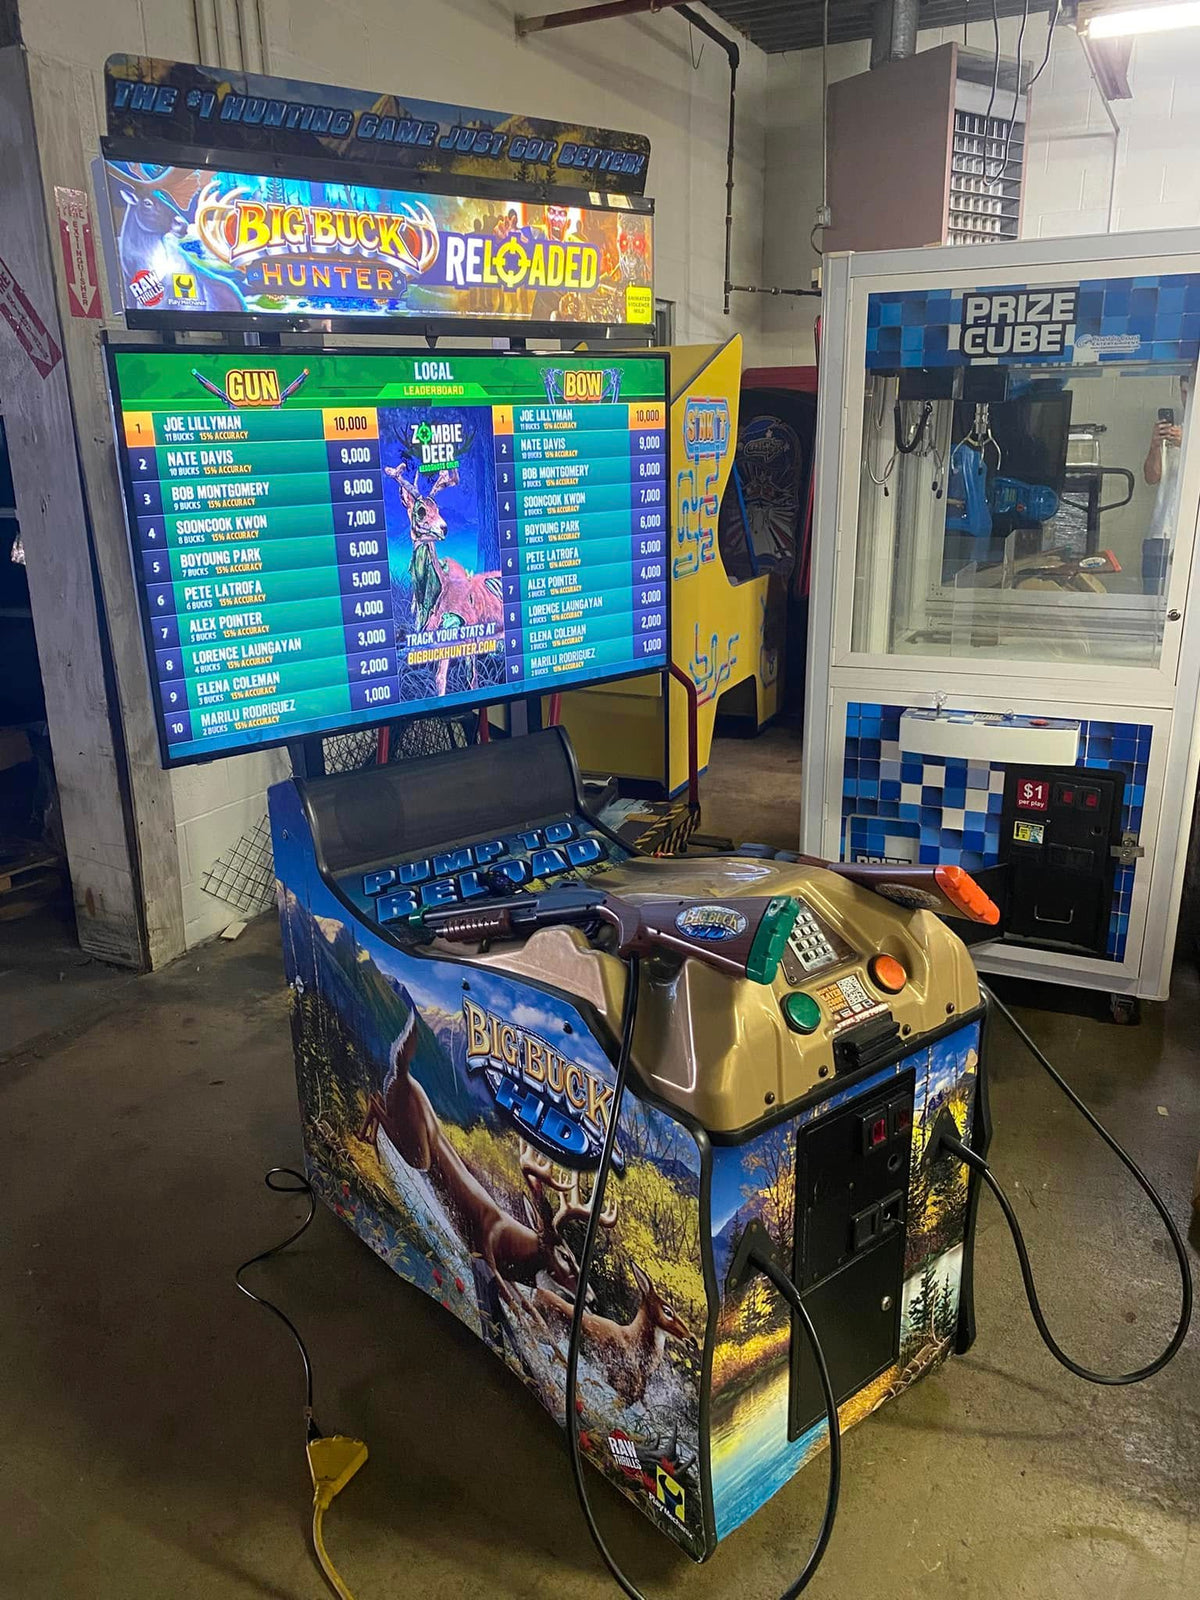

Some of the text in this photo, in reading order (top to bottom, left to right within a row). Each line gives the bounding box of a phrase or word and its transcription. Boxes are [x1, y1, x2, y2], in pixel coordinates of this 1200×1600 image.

[113, 80, 645, 175] THE #1 HUNTING GAME JUST GOT BETTER!
[234, 202, 419, 270] BIG BUCK
[72, 220, 88, 306] EXTINGUISHER
[447, 236, 597, 288] RELOADED
[130, 270, 160, 297] RAW
[262, 263, 393, 291] HUNTER
[138, 283, 164, 304] THRILLS
[966, 292, 1076, 324] PRIZE
[414, 362, 454, 380] LOCAL
[228, 371, 279, 401] GUN
[404, 386, 464, 396] LEADERBOARD
[565, 372, 602, 397] BOW
[333, 416, 367, 431] 10,000
[501, 415, 504, 423] 1
[520, 409, 572, 422] JOE LILLYMAN
[636, 410, 659, 423] 10,000
[136, 424, 141, 434] 1
[164, 416, 241, 432] JOE LILLYMAN
[215, 431, 248, 440] ACCURACY
[411, 422, 463, 445] ZOMBIE
[502, 444, 506, 453] 2
[521, 438, 566, 451] NATE DAVIS
[640, 436, 660, 450] 9,000
[167, 450, 234, 466] NATE DAVIS
[341, 448, 371, 464] 9,000
[422, 444, 454, 464] DEER
[139, 459, 147, 470] 2
[178, 467, 200, 476] BUCKS
[203, 466, 217, 475] 15%
[219, 465, 252, 474] ACCURACY
[522, 464, 589, 480] BOB MONTGOMERY
[640, 463, 660, 477] 8,000
[503, 473, 508, 483] 3
[172, 482, 269, 500] BOB MONTGOMERY
[344, 479, 373, 495] 8,000
[144, 494, 151, 505] 3
[524, 492, 585, 508] SOONCOOK KWON
[640, 488, 660, 503] 7,000
[180, 502, 201, 510] BUCKS
[207, 500, 221, 508] 15%
[223, 498, 255, 507] ACCURACY
[504, 502, 510, 511] 4
[176, 515, 268, 535] SOONCOOK KWON
[347, 510, 376, 527] 7,000
[640, 514, 660, 528] 6,000
[148, 528, 156, 538] 4
[506, 530, 511, 540] 5
[525, 520, 579, 536] BOYOUNG PARK
[184, 535, 205, 543] BUCKS
[226, 530, 259, 540] ACCURACY
[350, 540, 378, 557] 6,000
[640, 539, 660, 554] 5,000
[180, 548, 261, 568] BOYOUNG PARK
[507, 558, 512, 567] 6
[526, 547, 579, 563] PETE LATROFA
[153, 562, 160, 573] 5
[188, 568, 208, 576] BUCKS
[215, 566, 228, 574] 15%
[230, 562, 263, 573] ACCURACY
[641, 564, 661, 579] 4,000
[352, 571, 381, 587] 5,000
[528, 574, 577, 590] ALEX POINTER
[184, 580, 262, 601] PETE LATROFA
[509, 586, 513, 594] 7
[641, 590, 661, 604] 3,000
[157, 595, 164, 606] 6
[355, 600, 384, 617] 4,000
[529, 596, 602, 617] LORENCE LAUNGAYAN
[190, 612, 263, 633] ALEX POINTER
[510, 612, 515, 621] 8
[641, 614, 661, 629] 2,000
[161, 628, 168, 638] 7
[358, 629, 386, 646] 3,000
[406, 623, 496, 647] TRACK YOUR STATS AT
[530, 624, 586, 643] ELENA COLEMAN
[192, 638, 302, 665] LORENCE LAUNGAYAN
[511, 639, 516, 648] 9
[643, 638, 661, 652] 1,000
[408, 640, 496, 665] BIGBUCKHUNTER.COM
[531, 648, 596, 669] MARILU RODRIGUEZ
[166, 660, 173, 670] 8
[360, 658, 388, 674] 2,000
[511, 665, 518, 674] 10
[197, 671, 280, 696] ELENA COLEMAN
[170, 692, 177, 702] 9
[364, 686, 391, 702] 1,000
[200, 699, 296, 727] MARILU RODRIGUEZ
[172, 723, 183, 733] 10
[1024, 783, 1042, 799] $1
[1030, 800, 1044, 808] play
[363, 822, 572, 895] PUMP TO
[376, 838, 601, 924] RELOAD
[684, 909, 738, 931] BIG BUCK
[465, 1000, 623, 1158] BIG BUCK
[496, 1076, 589, 1155] HD
[608, 1437, 637, 1458] RAW
[614, 1454, 642, 1470] THRILLS
